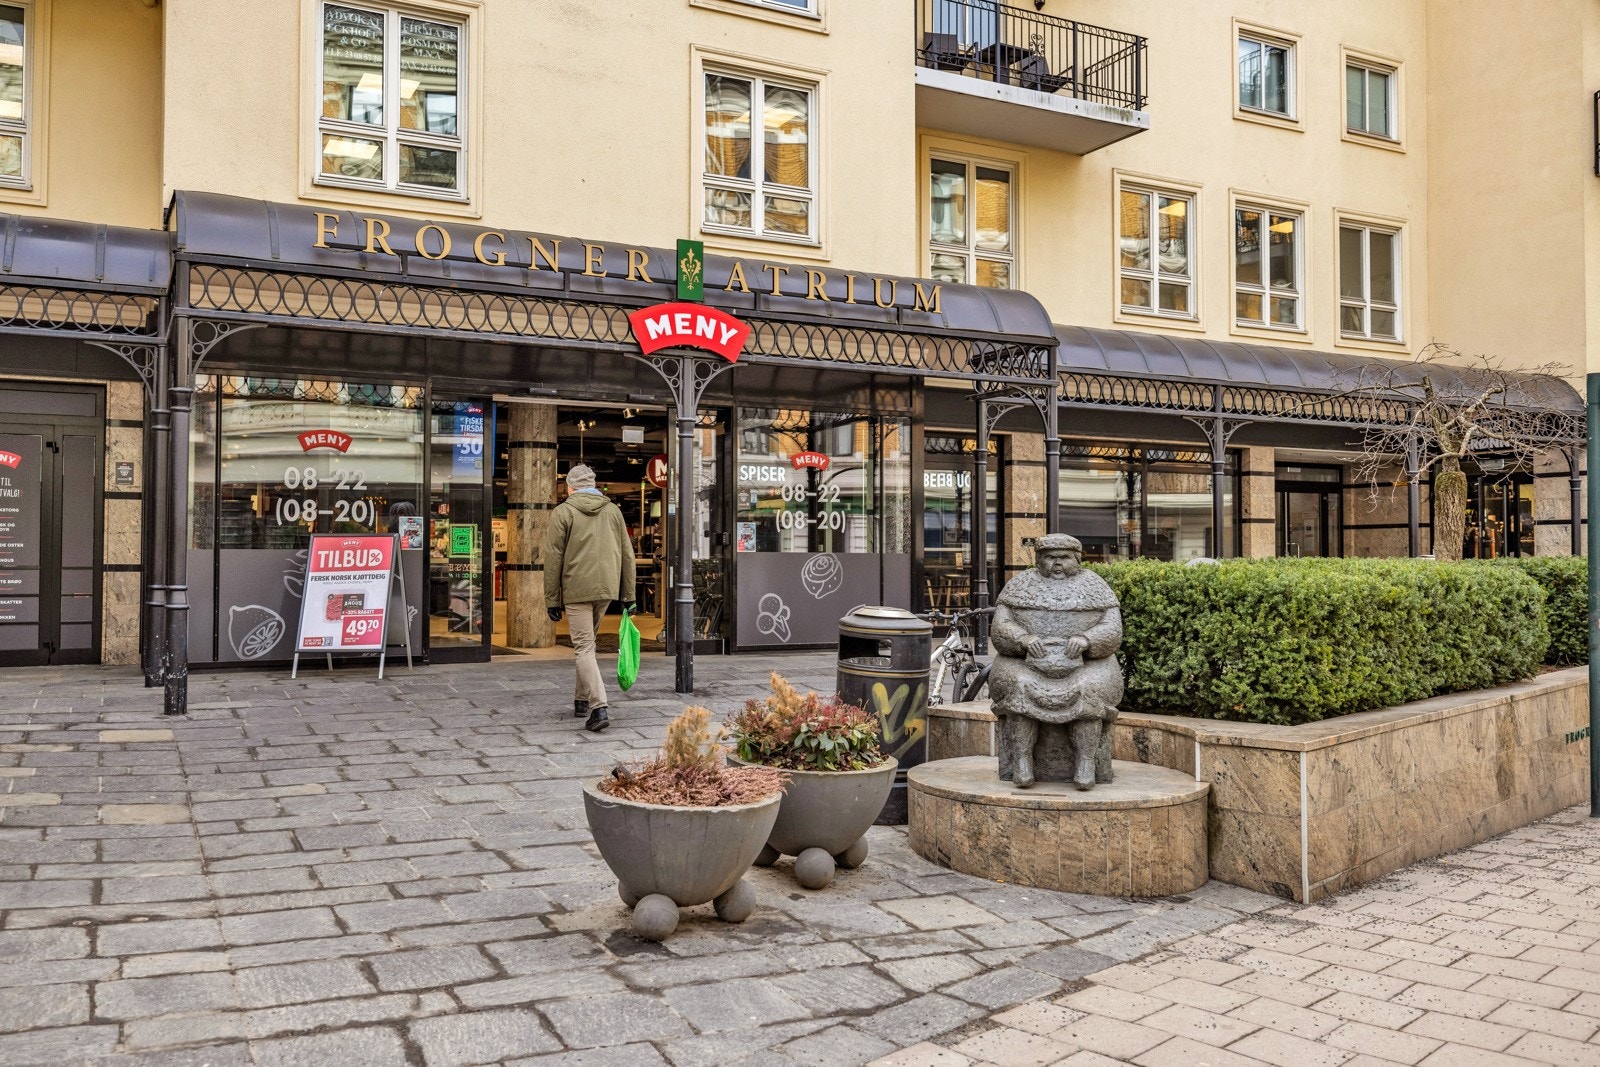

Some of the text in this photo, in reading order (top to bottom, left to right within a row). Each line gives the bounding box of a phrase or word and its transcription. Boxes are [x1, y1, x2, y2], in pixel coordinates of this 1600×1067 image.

[325, 10, 381, 27] ADVOKAT
[340, 36, 367, 47] & CO
[401, 36, 455, 53] FOSMARK
[312, 211, 943, 315] FROGNER ATRIUM
[693, 275, 700, 283] A
[643, 312, 739, 347] MENY
[303, 433, 347, 447] MENY
[795, 454, 827, 466] MENY
[740, 464, 786, 482] SPISER
[1, 477, 12, 487] TIL
[317, 548, 384, 569] TILBUD
[310, 573, 386, 582] FERSK NORSK KJØTTDEIG
